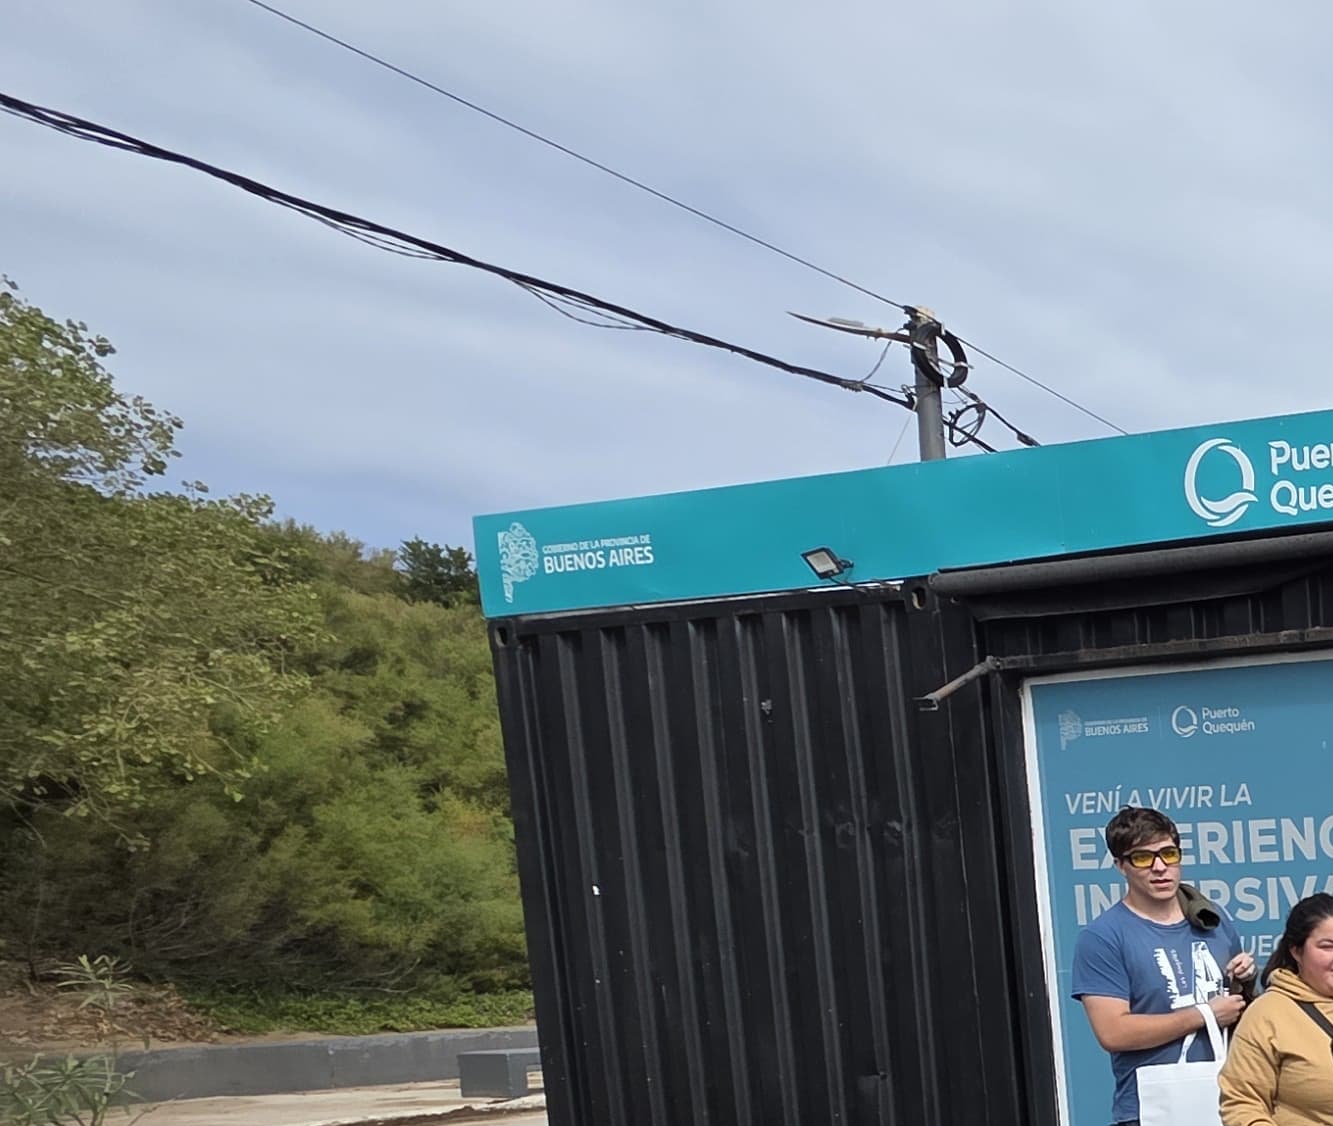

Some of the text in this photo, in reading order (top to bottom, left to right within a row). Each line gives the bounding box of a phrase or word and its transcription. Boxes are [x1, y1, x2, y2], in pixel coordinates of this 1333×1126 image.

[543, 546, 655, 574] BUENOS AIRES
[1202, 706, 1240, 720] Puerto
[1084, 722, 1149, 737] BUENOS AIRES
[1202, 719, 1255, 735] Quequén
[1065, 783, 1252, 815] VENÍ A VIVIR LA
